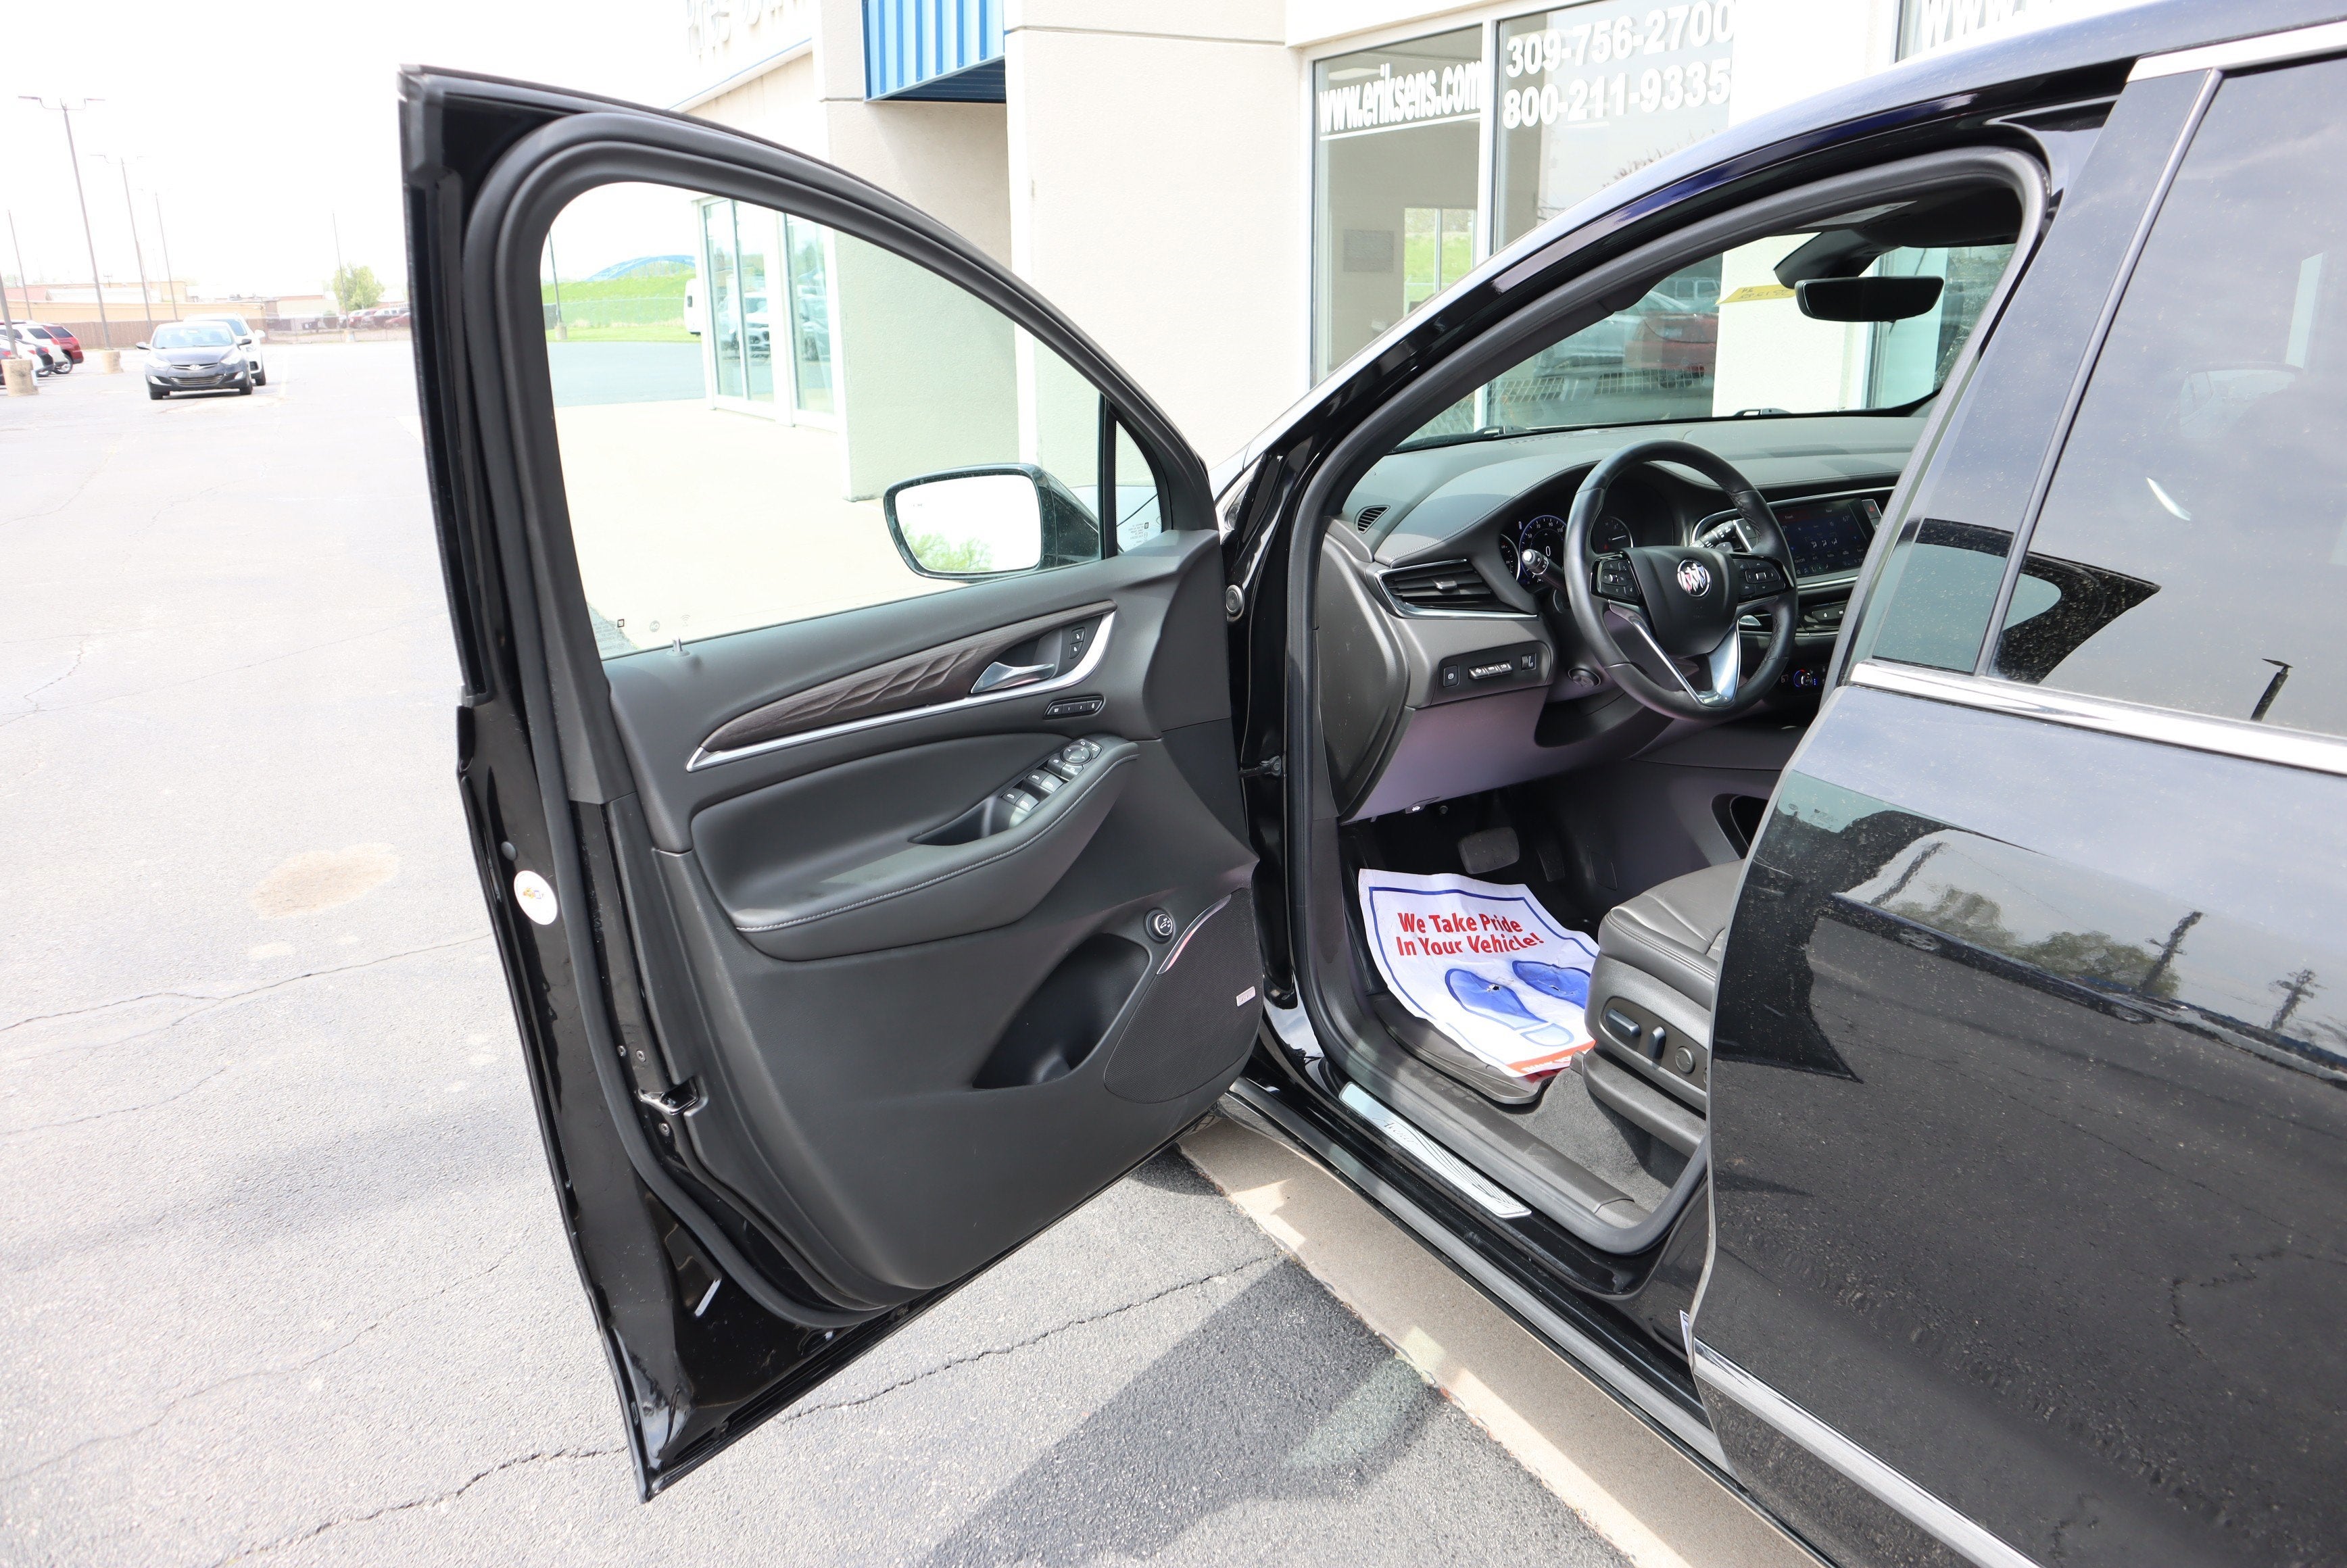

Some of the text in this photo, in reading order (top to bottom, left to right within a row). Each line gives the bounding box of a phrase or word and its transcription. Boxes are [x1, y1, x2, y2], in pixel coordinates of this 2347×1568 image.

[1505, 0, 1735, 78] 309-756-2700
[1319, 60, 1482, 133] www.eriksens.com
[1503, 57, 1731, 129] 800-211-9335
[1396, 932, 1545, 956] In Your Vehicle!
[1397, 912, 1523, 933] We Take Pride
